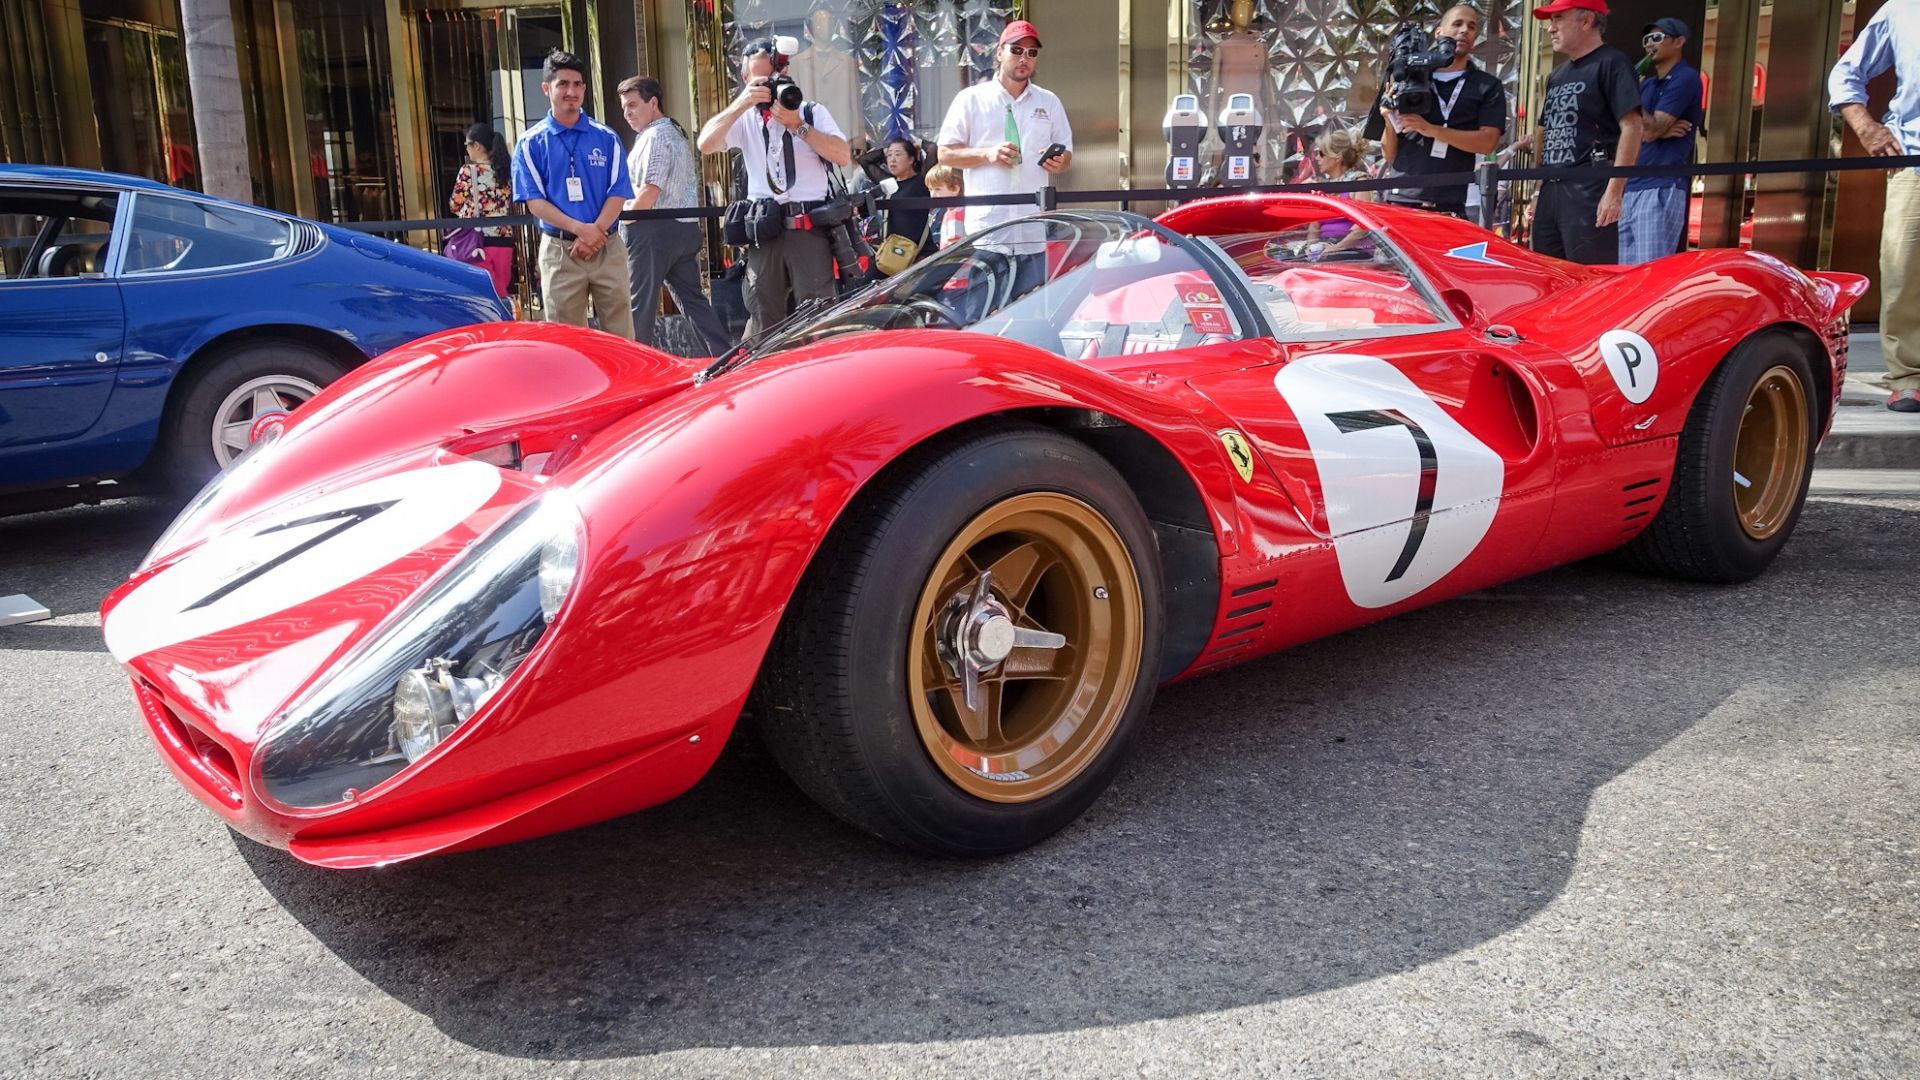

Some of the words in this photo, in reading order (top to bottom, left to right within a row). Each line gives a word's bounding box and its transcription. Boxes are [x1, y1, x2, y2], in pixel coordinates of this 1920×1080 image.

[1544, 94, 1579, 115] CASA
[1547, 81, 1586, 98] MUSEO
[1202, 312, 1213, 321] P
[1615, 342, 1642, 388] P
[1324, 408, 1438, 583] 7
[176, 498, 403, 614] 7
